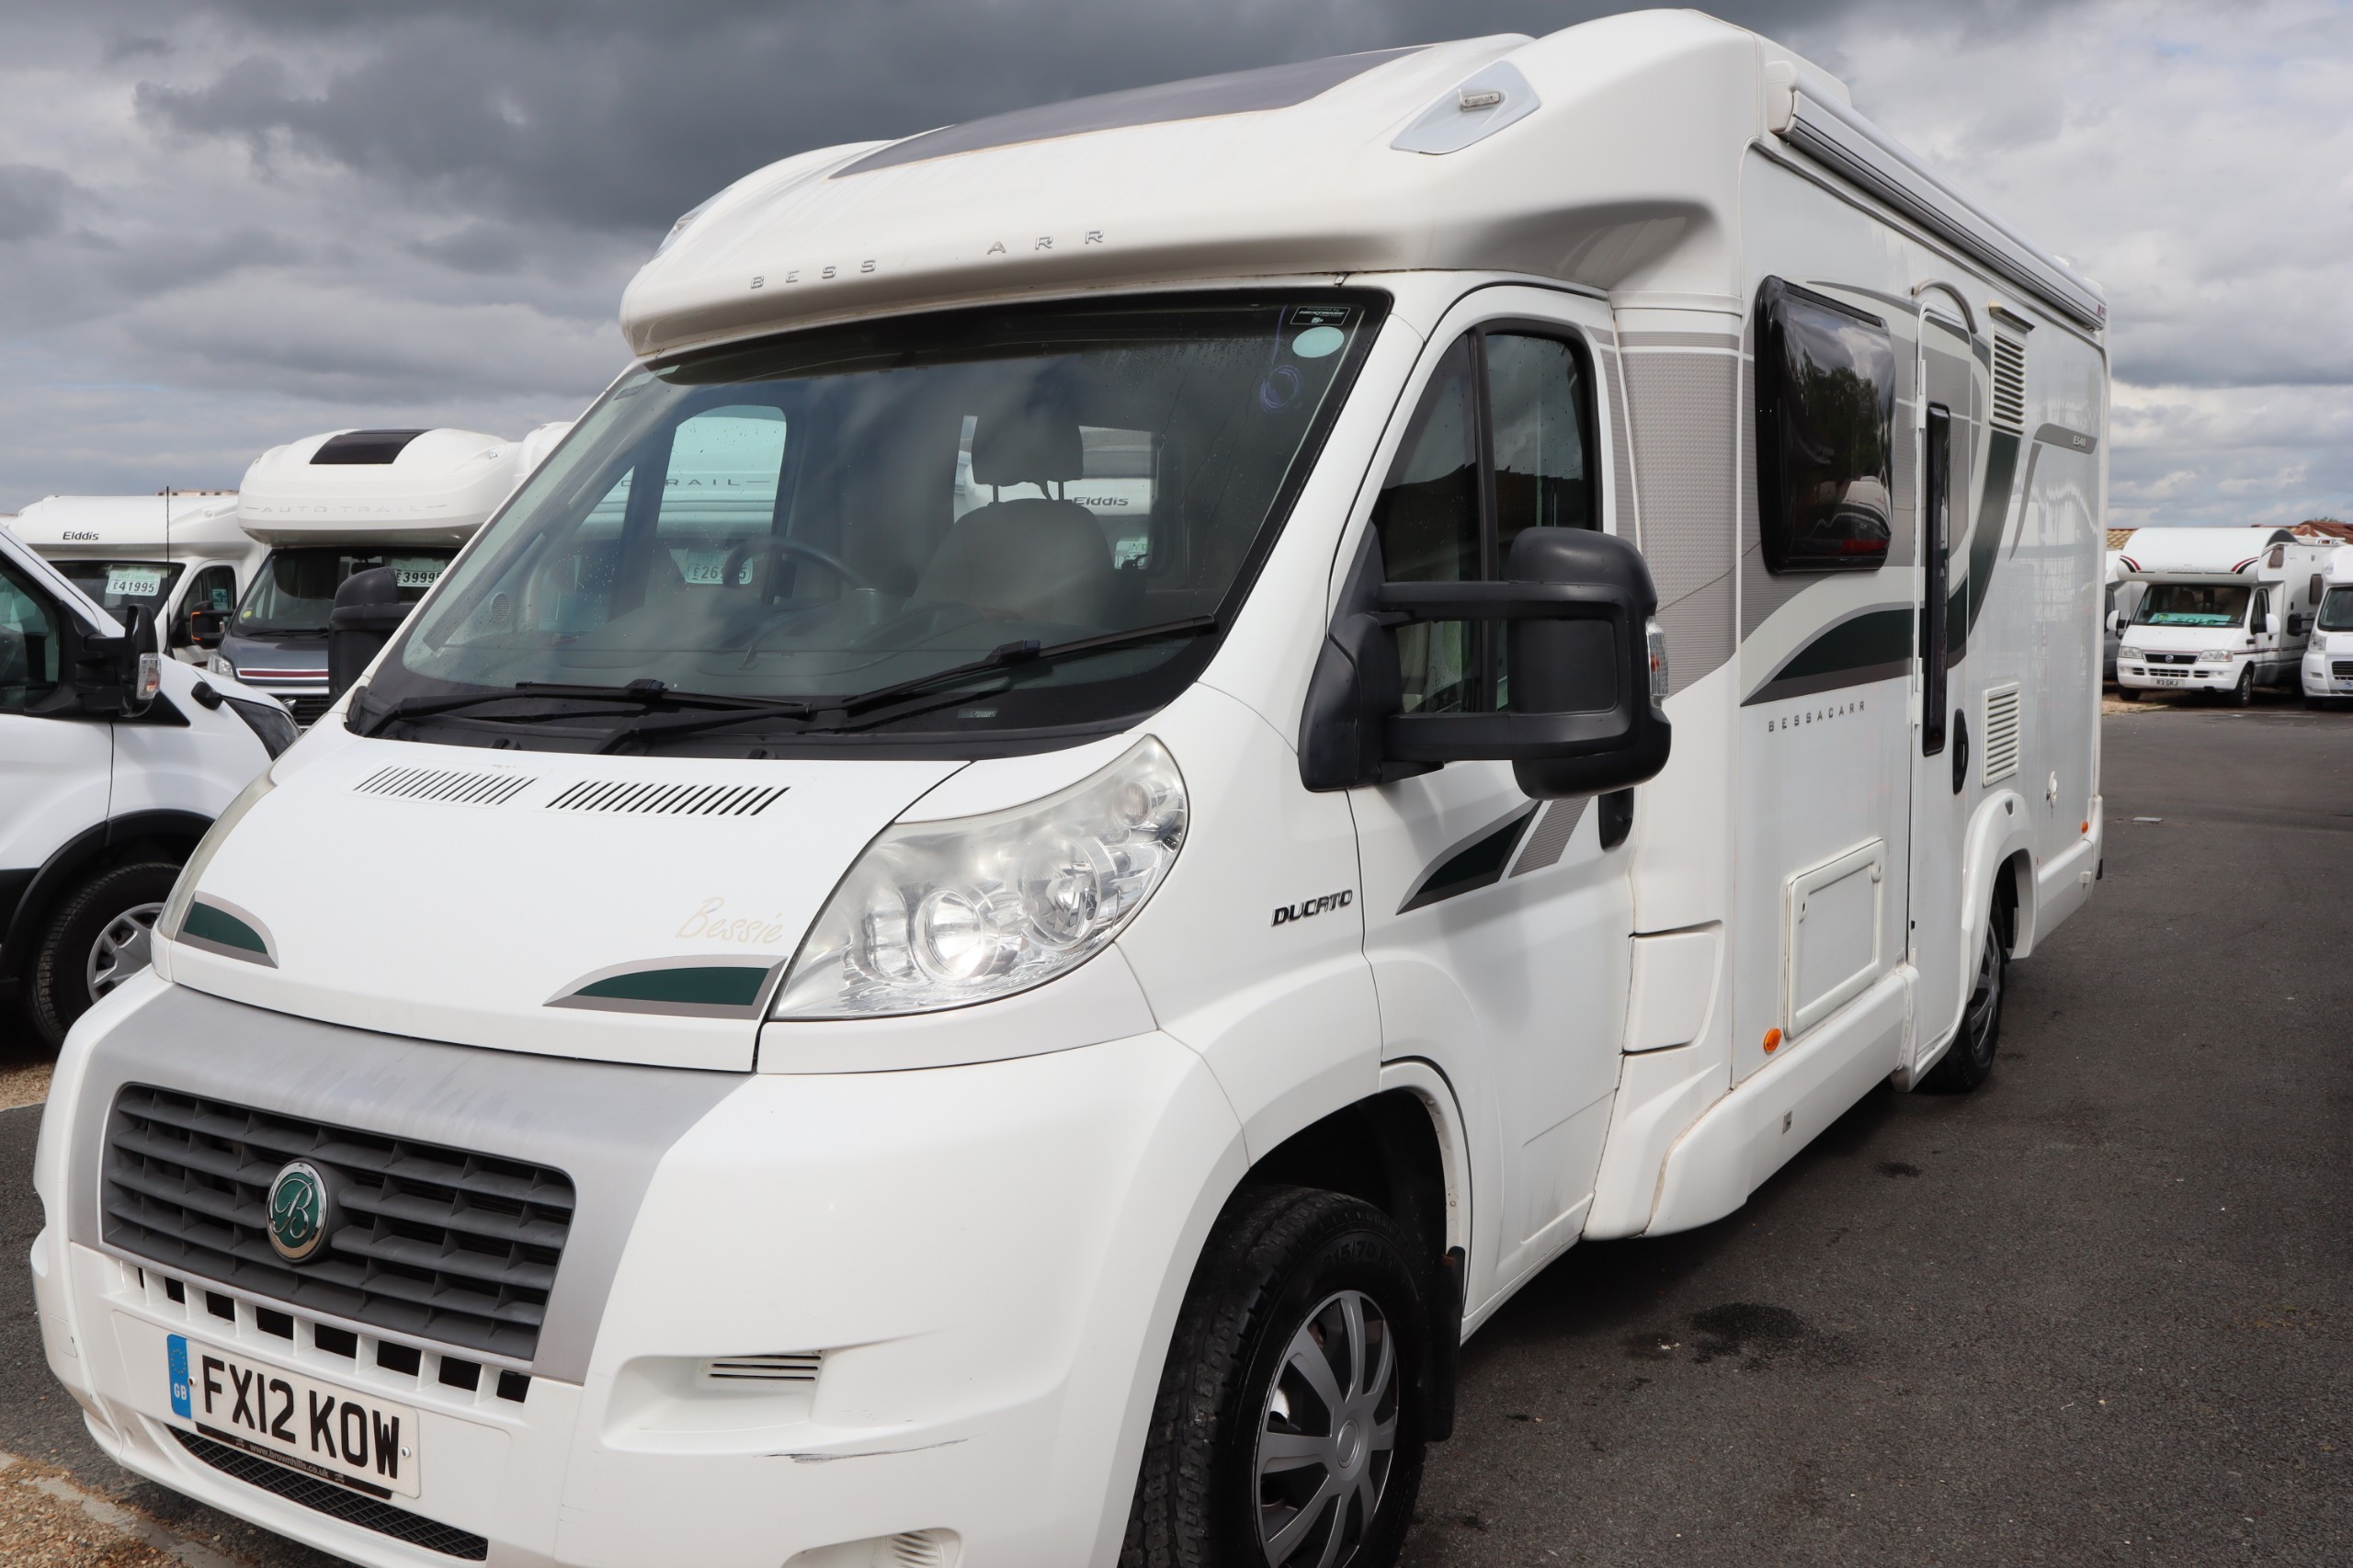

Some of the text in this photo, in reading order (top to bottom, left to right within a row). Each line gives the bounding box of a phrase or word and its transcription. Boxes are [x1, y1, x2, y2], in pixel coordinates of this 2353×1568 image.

[1073, 497, 1129, 506] Elddis
[63, 531, 100, 540] Elddis
[692, 565, 746, 580] £265
[113, 582, 154, 593] £41995
[1768, 701, 1864, 732] BESSACARR
[1271, 889, 1353, 926] DUCATO
[676, 896, 783, 945] Bessie
[174, 1382, 188, 1401] GB
[309, 1390, 400, 1479] KOW
[249, 1443, 329, 1479] www.brownhills.co.uk
